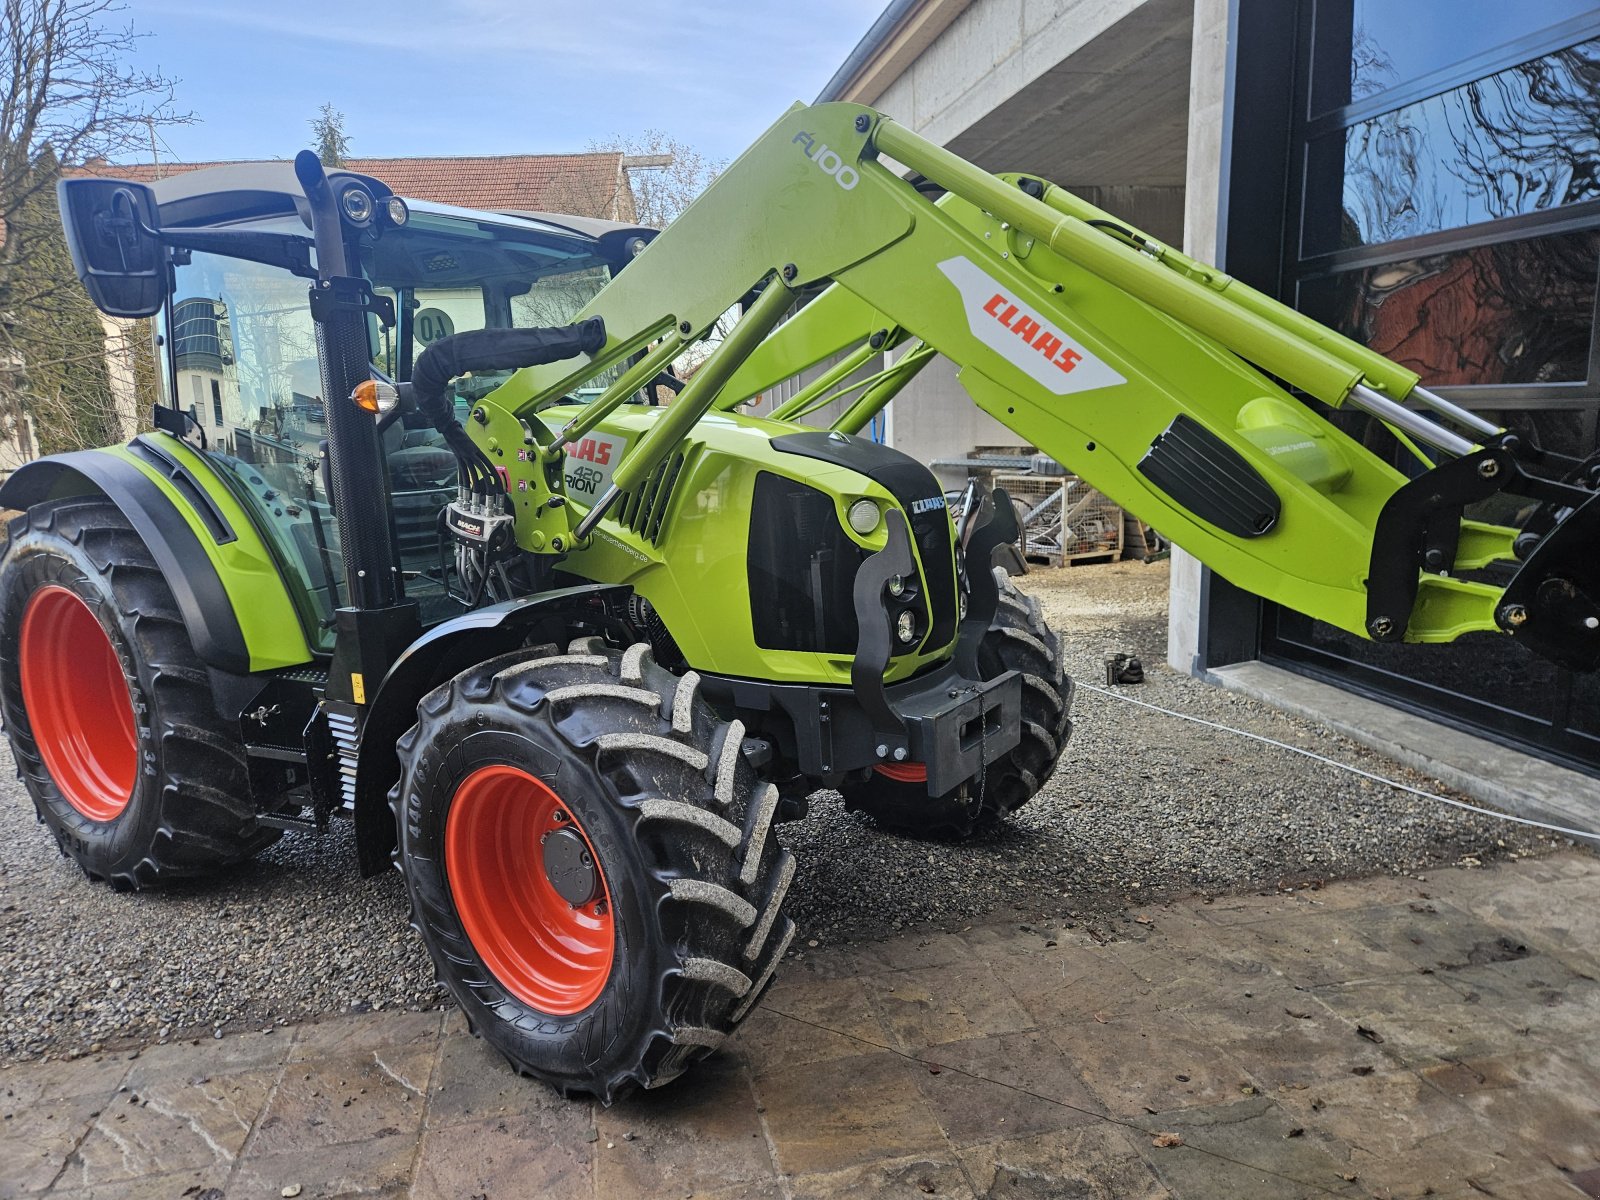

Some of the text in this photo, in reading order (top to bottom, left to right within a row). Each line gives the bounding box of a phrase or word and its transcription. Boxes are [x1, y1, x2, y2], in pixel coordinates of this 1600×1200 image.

[791, 130, 860, 192] FL100
[982, 293, 1083, 374] CLAAS
[555, 432, 613, 466] AAS
[564, 474, 597, 495] RION
[573, 465, 604, 484] 420
[911, 496, 946, 515] CLAAS
[457, 519, 481, 532] MACH
[144, 749, 158, 777] 34
